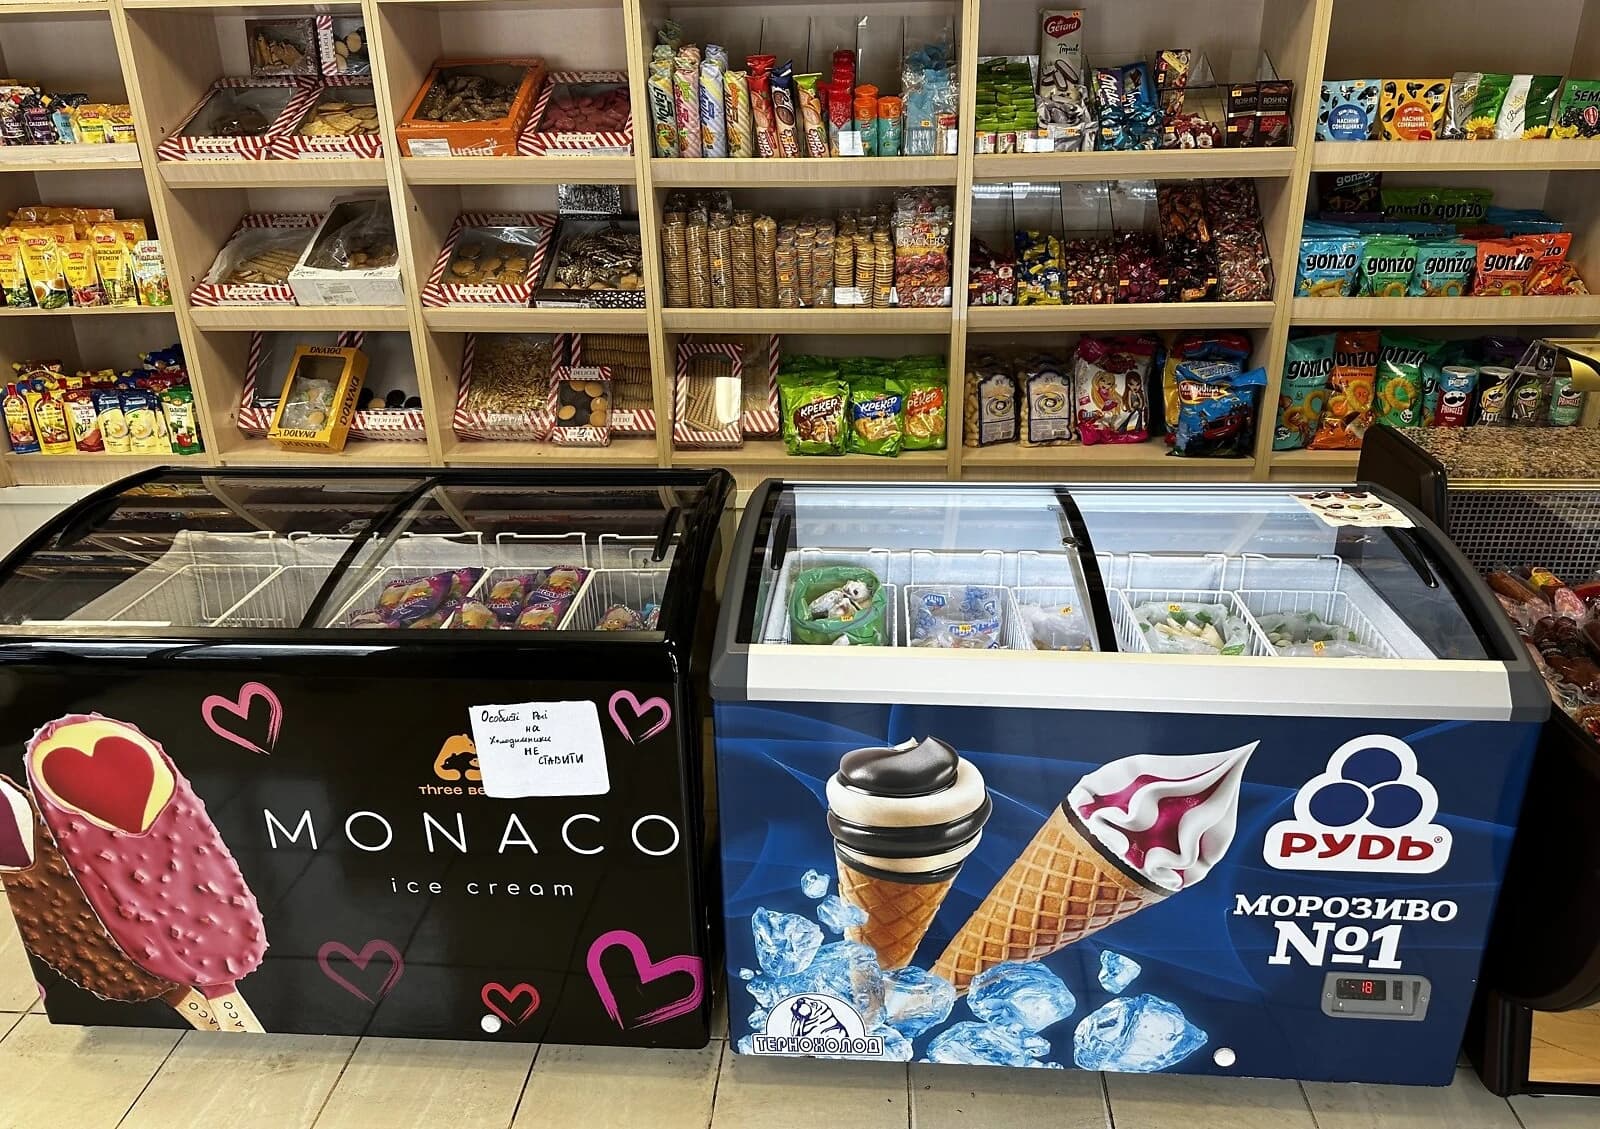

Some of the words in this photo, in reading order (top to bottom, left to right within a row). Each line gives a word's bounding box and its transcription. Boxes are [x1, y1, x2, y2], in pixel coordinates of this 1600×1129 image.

[1046, 20, 1078, 34] Gerard
[653, 86, 670, 123] LEMON
[1574, 90, 1600, 102] SEM
[1336, 172, 1371, 186] gonzo
[896, 235, 946, 249] CRACKERS
[1306, 253, 1357, 272] gonzo
[1367, 257, 1416, 276] gonzo
[1423, 256, 1473, 275] gonzo
[1484, 253, 1535, 272] gonzo
[309, 346, 342, 355] DOLYNA
[1335, 351, 1377, 367] onzo
[1287, 357, 1332, 381] gonzo
[339, 376, 361, 426] DOLYNA
[800, 398, 838, 417] КРЕКЕР
[861, 396, 897, 412] КРЕКЕР
[906, 391, 938, 410] РЕКЕР
[1440, 405, 1465, 415] PRINGLES
[283, 430, 317, 439] DOLYNA
[525, 725, 541, 733] на
[524, 746, 540, 756] НЕ
[538, 753, 584, 765] СТАВИТИ
[263, 808, 680, 857] MONACO
[1279, 832, 1434, 862] РУДЬ
[391, 877, 442, 895] ice
[467, 881, 574, 897] cream
[1232, 893, 1458, 922] МОРОЗИВО
[1267, 920, 1403, 970] №1
[756, 1036, 881, 1054] ТЕРНОХОЛОД
